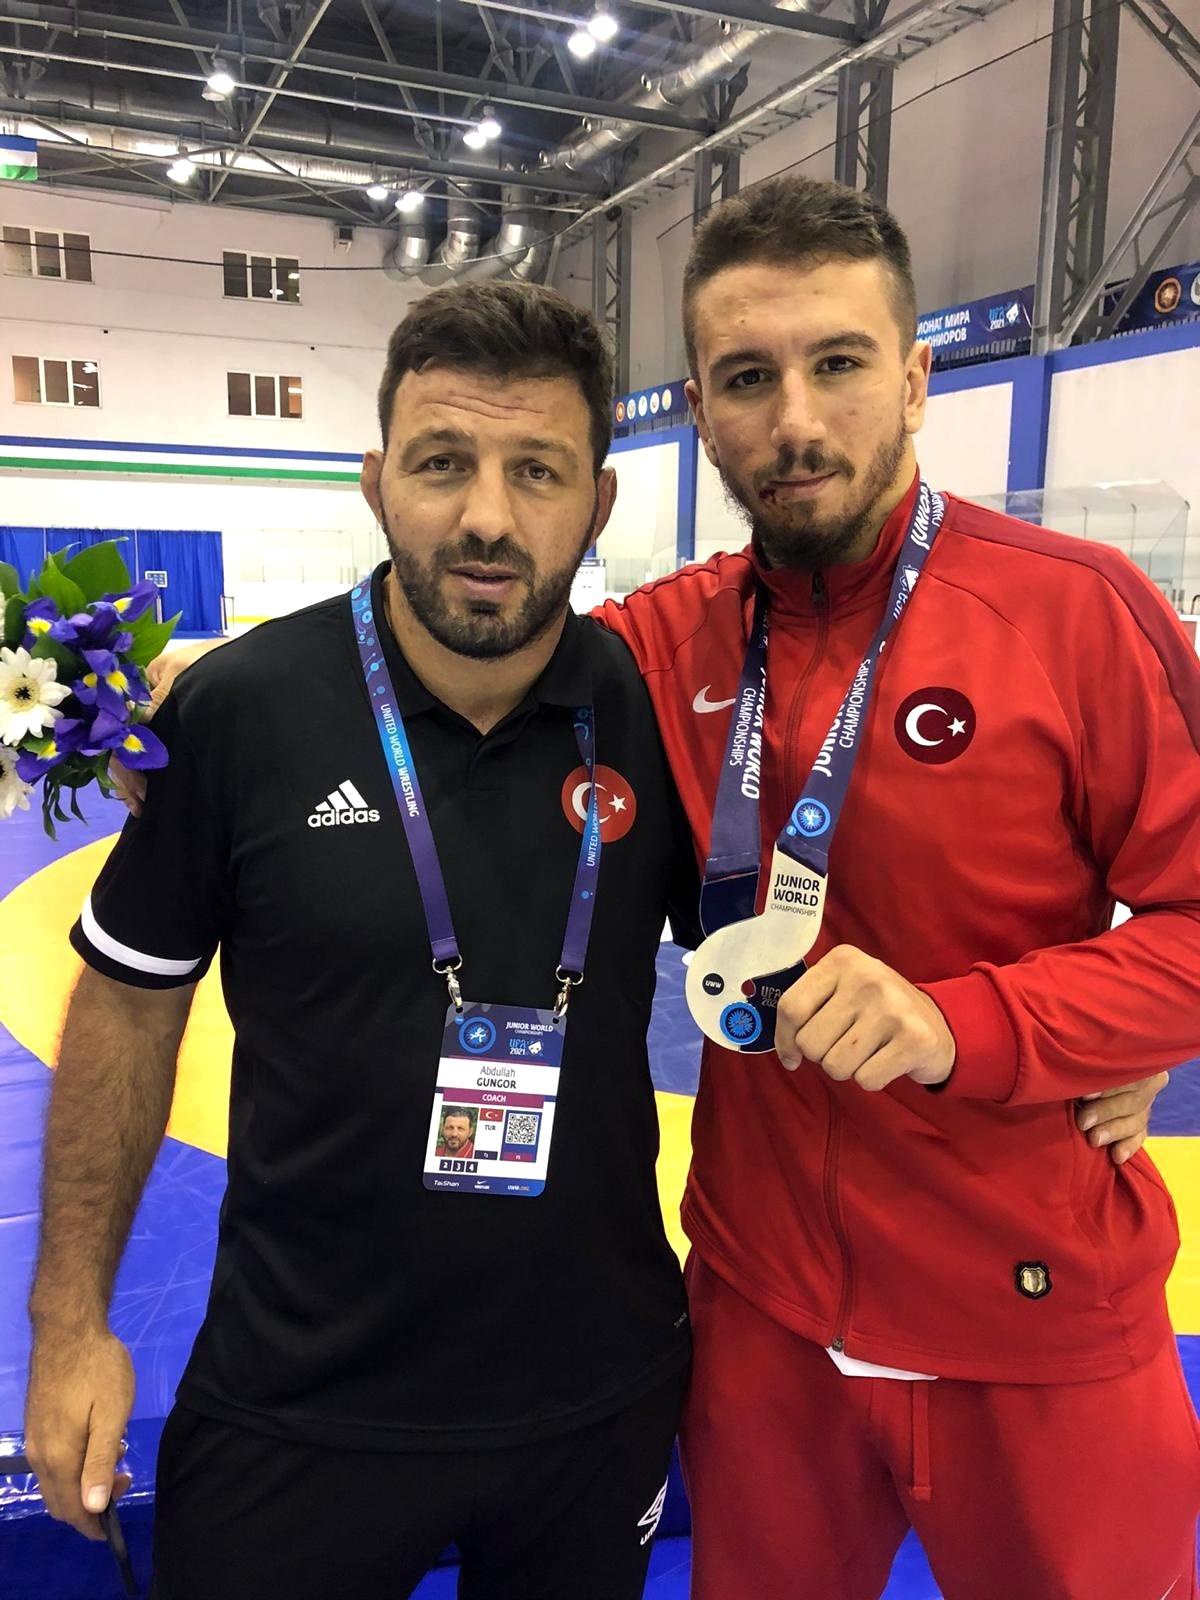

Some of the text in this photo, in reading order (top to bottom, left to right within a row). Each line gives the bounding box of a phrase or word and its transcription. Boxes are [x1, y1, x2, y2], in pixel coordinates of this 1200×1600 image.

[944, 309, 970, 328] МИРА
[990, 319, 1005, 330] 2021
[839, 658, 871, 749] CHAMPIONSHIPS
[729, 687, 757, 767] CHAMPIONSHIPS
[380, 703, 420, 818] UNITED WORLD WRESTLING
[307, 808, 381, 828] adidas
[586, 835, 598, 867] UNITED
[774, 873, 820, 893] JUNIOR
[773, 888, 819, 907] WORLD
[770, 903, 817, 918] CHAMPIONSHIPS
[761, 998, 778, 1009] 202
[505, 1021, 554, 1033] JUNIOR WORLD
[509, 1047, 526, 1056] 2021
[480, 1066, 516, 1078] Abdullah
[476, 1077, 517, 1089] GUNGOR
[482, 1093, 507, 1103] COACH
